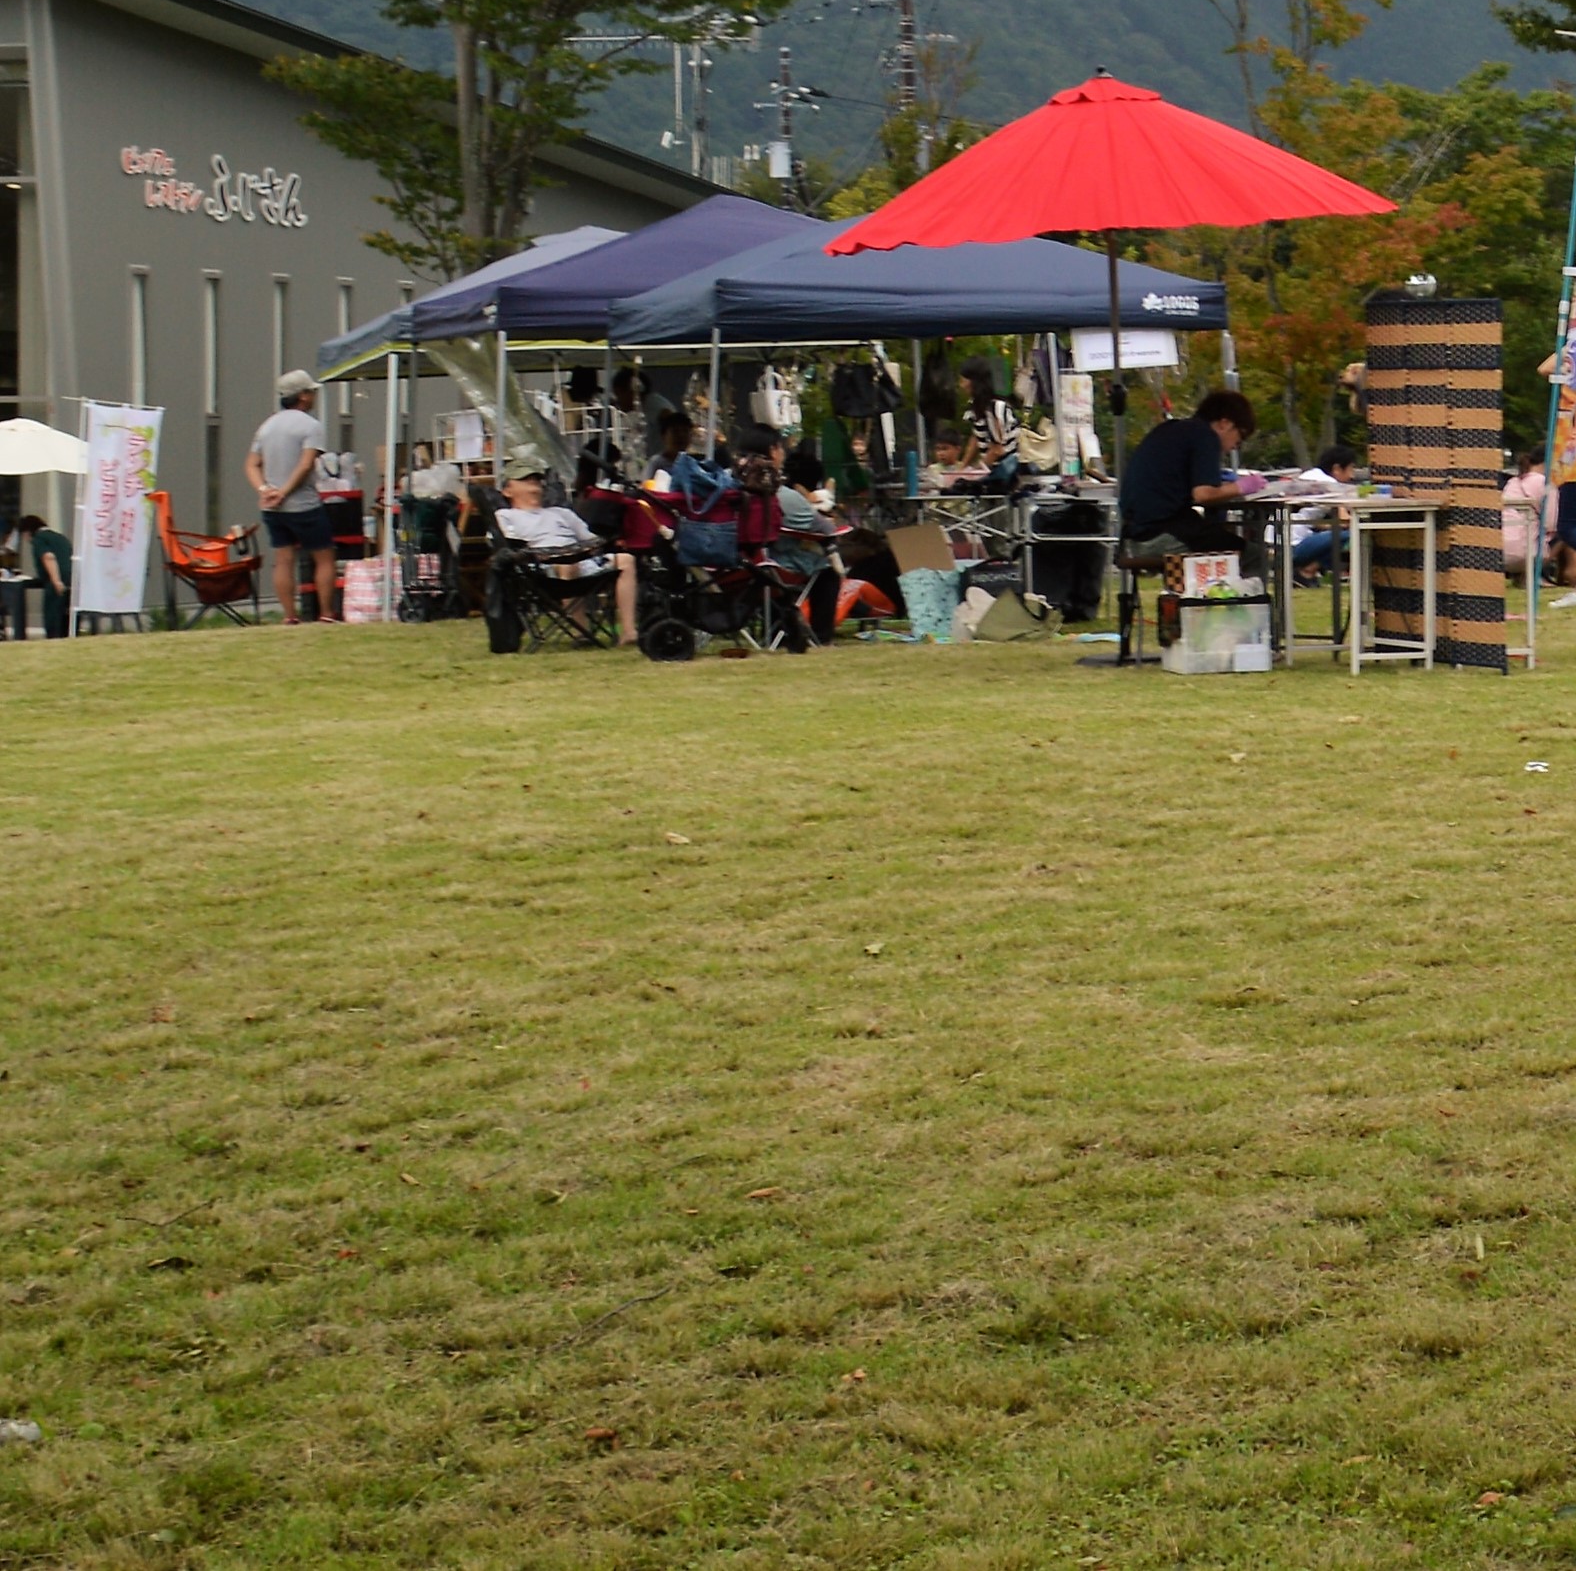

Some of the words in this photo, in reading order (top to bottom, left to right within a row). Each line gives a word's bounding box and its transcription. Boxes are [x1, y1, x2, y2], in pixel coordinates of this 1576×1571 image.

[144, 178, 204, 214] レストラン
[203, 153, 309, 228] ふじさん
[1162, 295, 1200, 310] LOGOS
